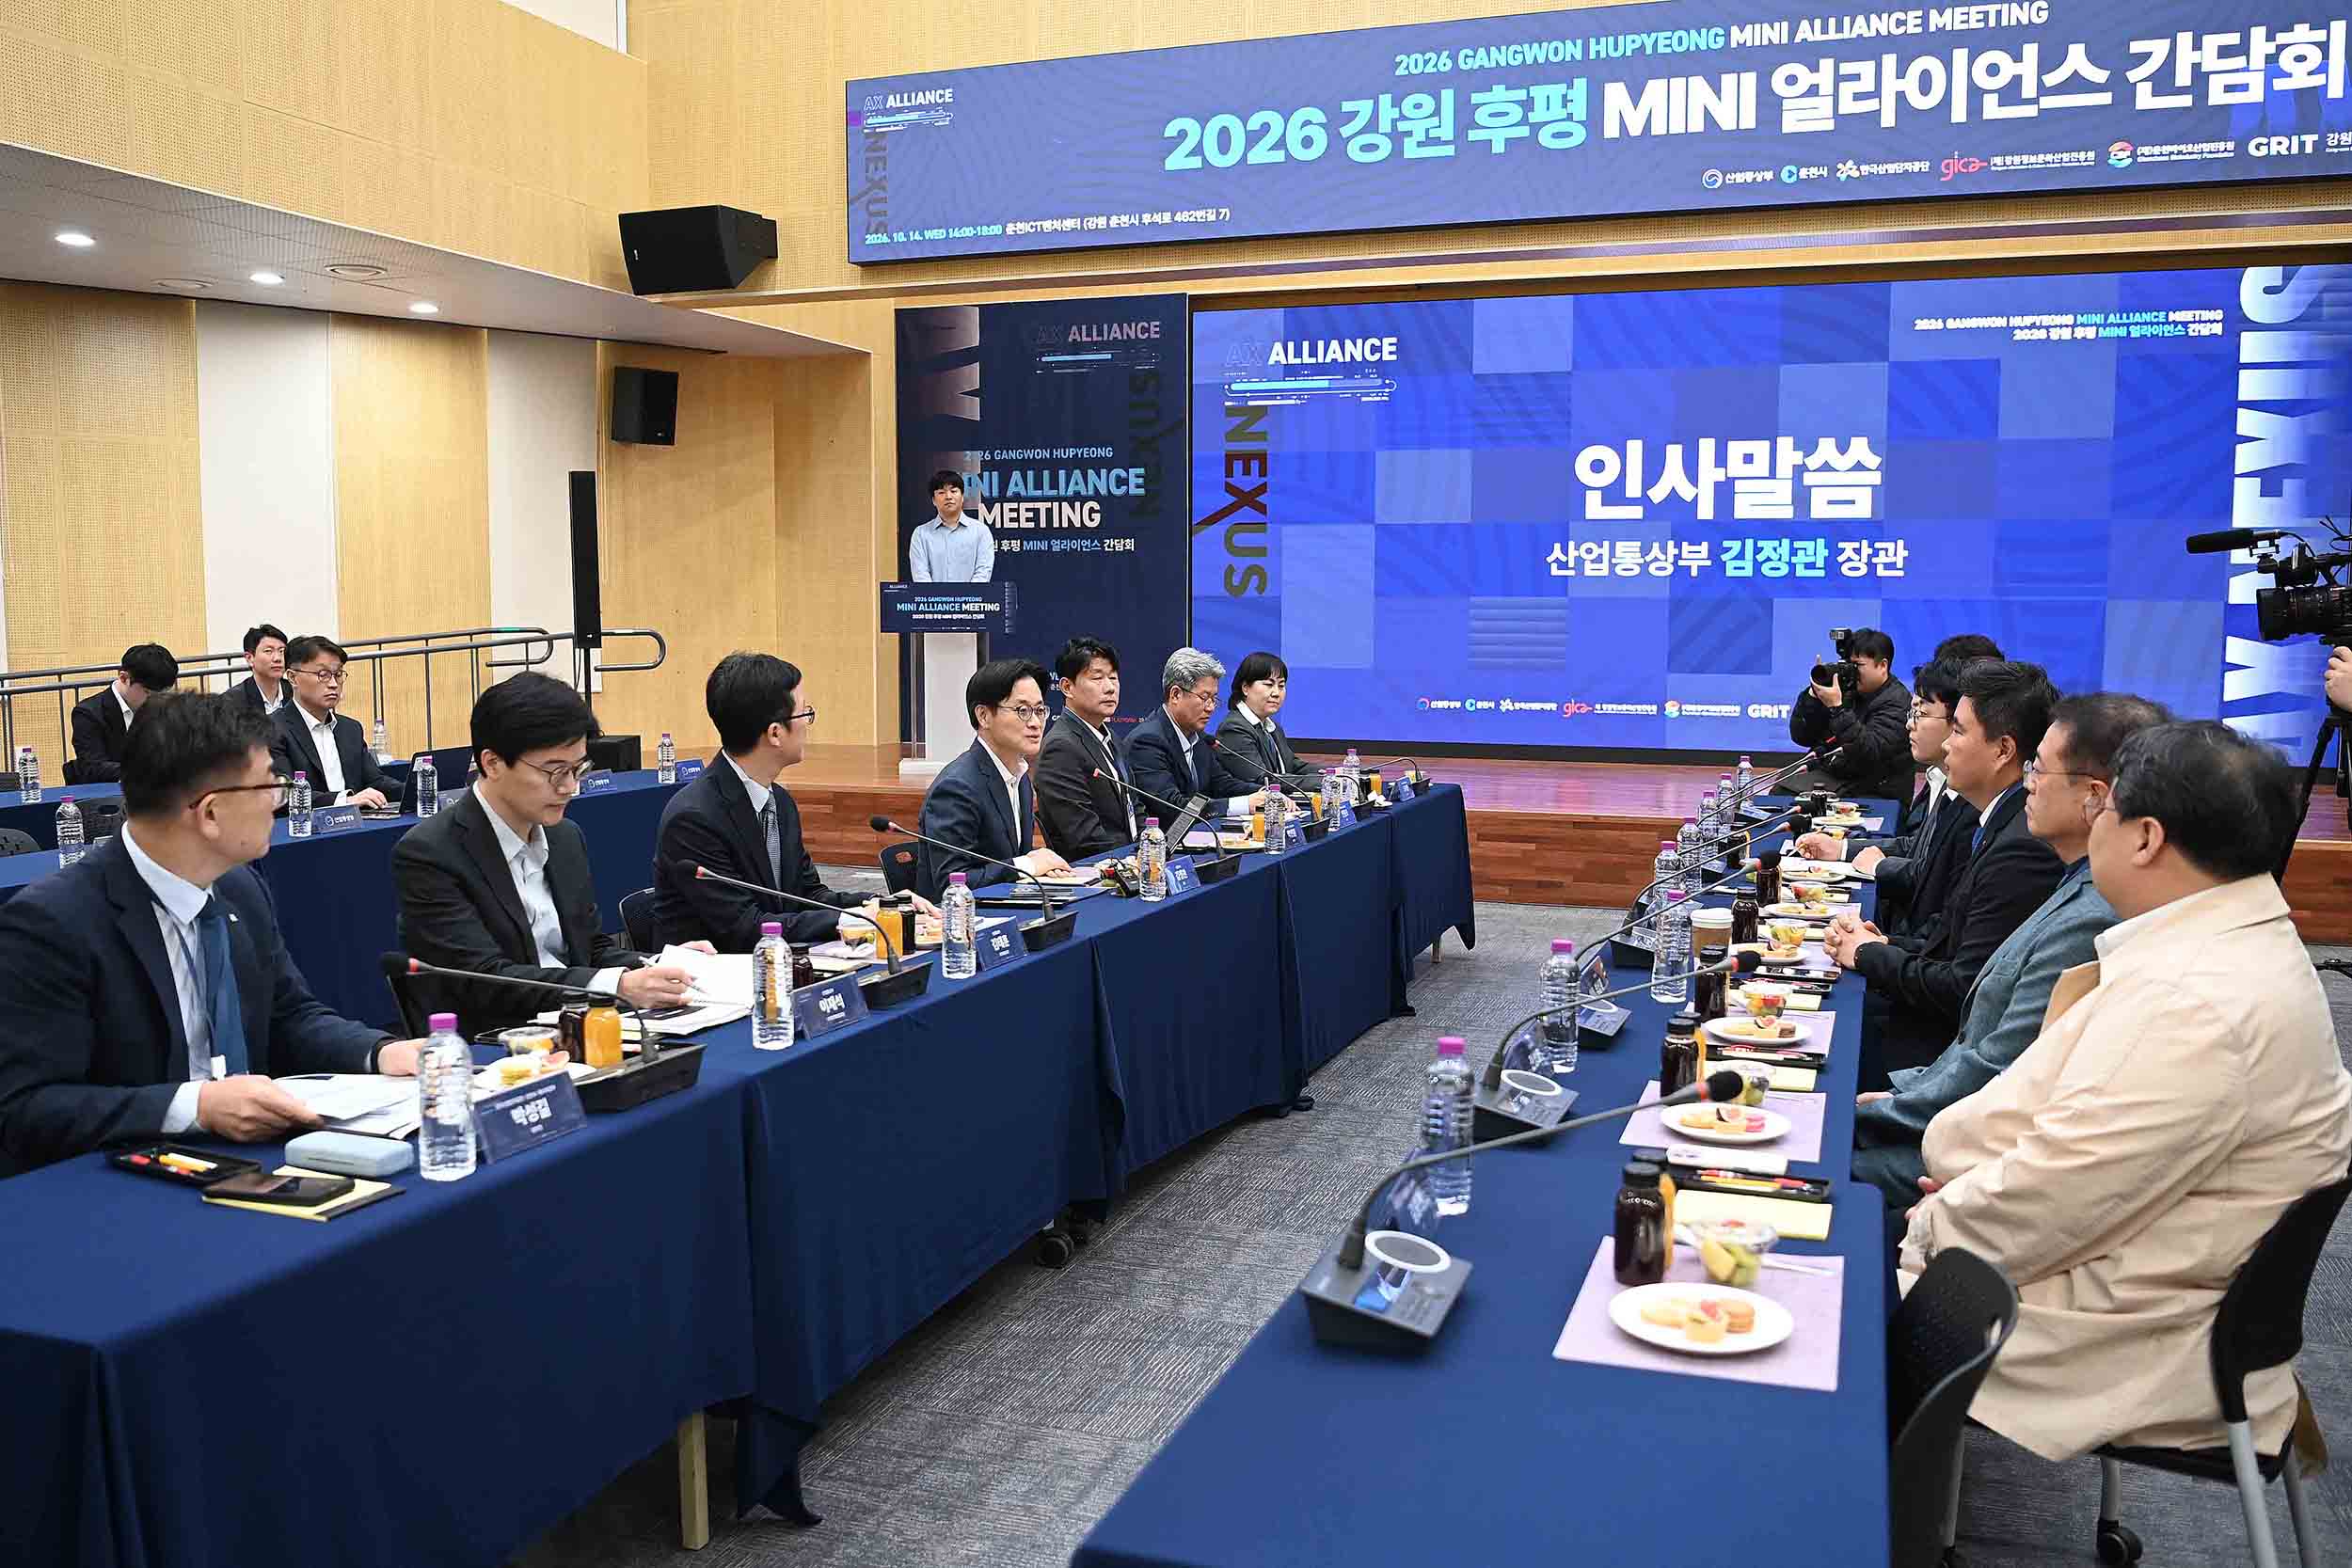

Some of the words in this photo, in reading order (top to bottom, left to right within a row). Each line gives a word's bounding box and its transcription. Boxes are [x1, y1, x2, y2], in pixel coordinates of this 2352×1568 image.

[1394, 51, 1454, 76] 2026
[1458, 39, 1582, 71] GANGWON
[1589, 27, 1725, 60] HUPYEONG
[1730, 21, 1788, 48] MINI
[1794, 9, 1923, 44] ALLIANCE
[1929, 1, 2049, 32] MEETING
[864, 95, 883, 111] AX
[886, 88, 954, 109] ALLIANCE
[1163, 106, 1328, 171] 2026
[1339, 89, 1455, 164] 강원
[1467, 78, 1588, 154] 후평
[1603, 71, 1757, 139] MINI
[1771, 42, 2113, 135] 얼라이언스
[2124, 20, 2347, 110] 간담회
[2248, 135, 2319, 157] GRIT
[924, 229, 946, 240] WED
[2076, 313, 2105, 325] MINI
[2107, 311, 2167, 324] ALLIANCE
[2168, 309, 2223, 322] MEETING
[1068, 321, 1160, 342] ALLIANCE
[2098, 326, 2127, 338] MINI
[2129, 324, 2185, 338] 얼라이언스
[1267, 337, 1398, 365] ALLIANCE
[964, 450, 991, 460] 226
[994, 448, 1050, 460] GANGWON
[1053, 447, 1113, 459] HUPYEONG
[963, 470, 999, 498] INI
[1006, 467, 1145, 497] ALLIANCE
[1574, 436, 1883, 520] 인사말씀
[1225, 406, 1267, 597] NEXUS
[978, 501, 1101, 529] MEETING
[1001, 539, 1021, 551] 후평
[1023, 540, 1047, 550] MINI
[1051, 539, 1101, 552] 얼라이언스
[1104, 538, 1135, 551] 간담회
[1545, 540, 1712, 578] 산업통상부
[1719, 537, 1829, 578] 김정관
[1836, 538, 1909, 578] 장관
[897, 603, 917, 611] MINI
[918, 602, 961, 611] ALLIANCE
[961, 602, 1000, 611] MEETING
[1747, 705, 1791, 719] GRIT
